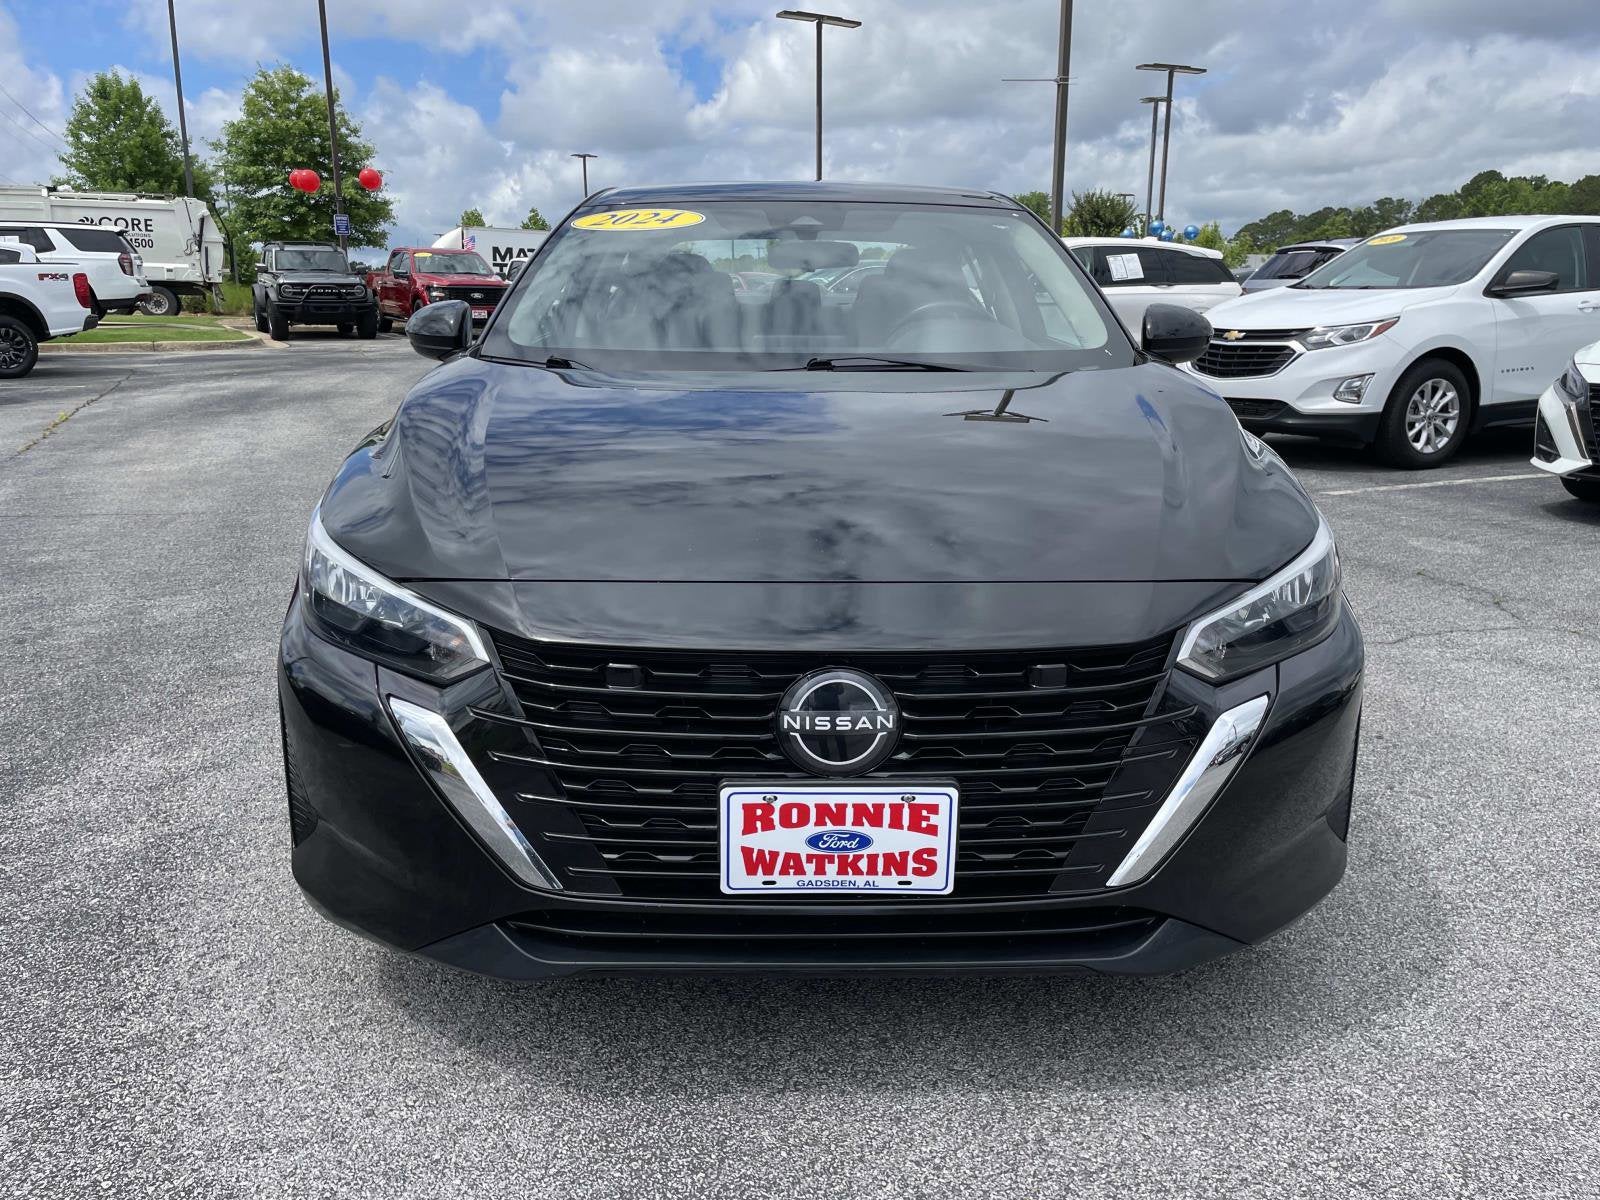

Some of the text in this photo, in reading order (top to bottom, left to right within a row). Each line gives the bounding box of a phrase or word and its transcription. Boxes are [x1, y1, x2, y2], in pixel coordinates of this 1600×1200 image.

[98, 216, 154, 232] CORE
[587, 212, 683, 226] 2024
[38, 273, 69, 281] FX4
[783, 714, 894, 731] NISSAN
[741, 803, 939, 837] RONNIE
[818, 832, 860, 849] Ford
[740, 846, 938, 877] WATKINS
[796, 879, 880, 889] GADSDEN, AL
